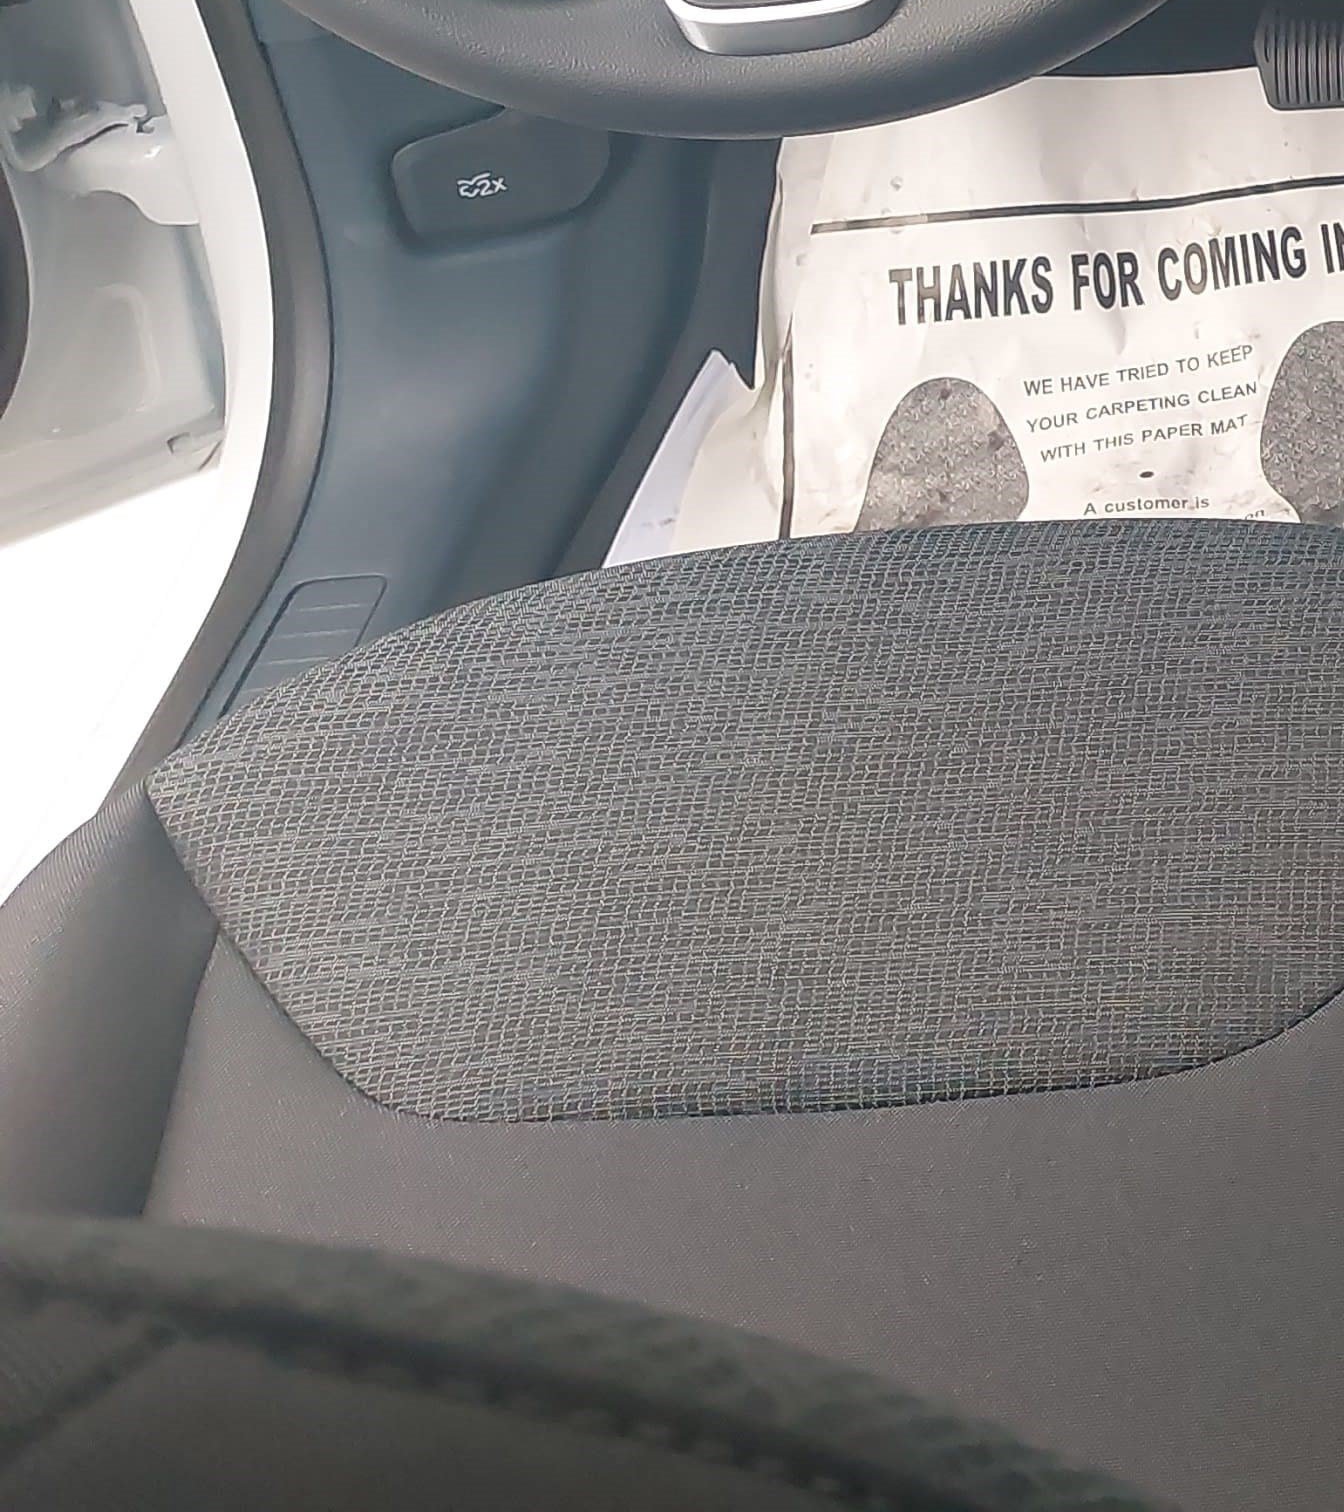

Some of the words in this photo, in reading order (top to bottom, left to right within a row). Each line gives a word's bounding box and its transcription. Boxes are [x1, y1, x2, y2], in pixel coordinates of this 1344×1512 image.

[888, 255, 1054, 326] THANKS
[1070, 252, 1144, 311] FOR
[1158, 225, 1307, 301] COMING
[1023, 378, 1053, 397] WE
[1060, 372, 1111, 394] HAVE
[1116, 362, 1169, 383] TRIED
[1175, 356, 1200, 374] TO
[1206, 344, 1254, 369] KEEP
[1026, 412, 1079, 434] YOUR
[1085, 393, 1191, 421] CARPETING
[1197, 381, 1258, 405] CLEAN
[1040, 442, 1087, 463] WITH
[1093, 433, 1135, 452] THIS
[1141, 423, 1204, 443] PAPER
[1210, 414, 1249, 436] MAT
[1082, 502, 1098, 516] A
[1104, 496, 1189, 514] customer
[1194, 496, 1210, 509] is
